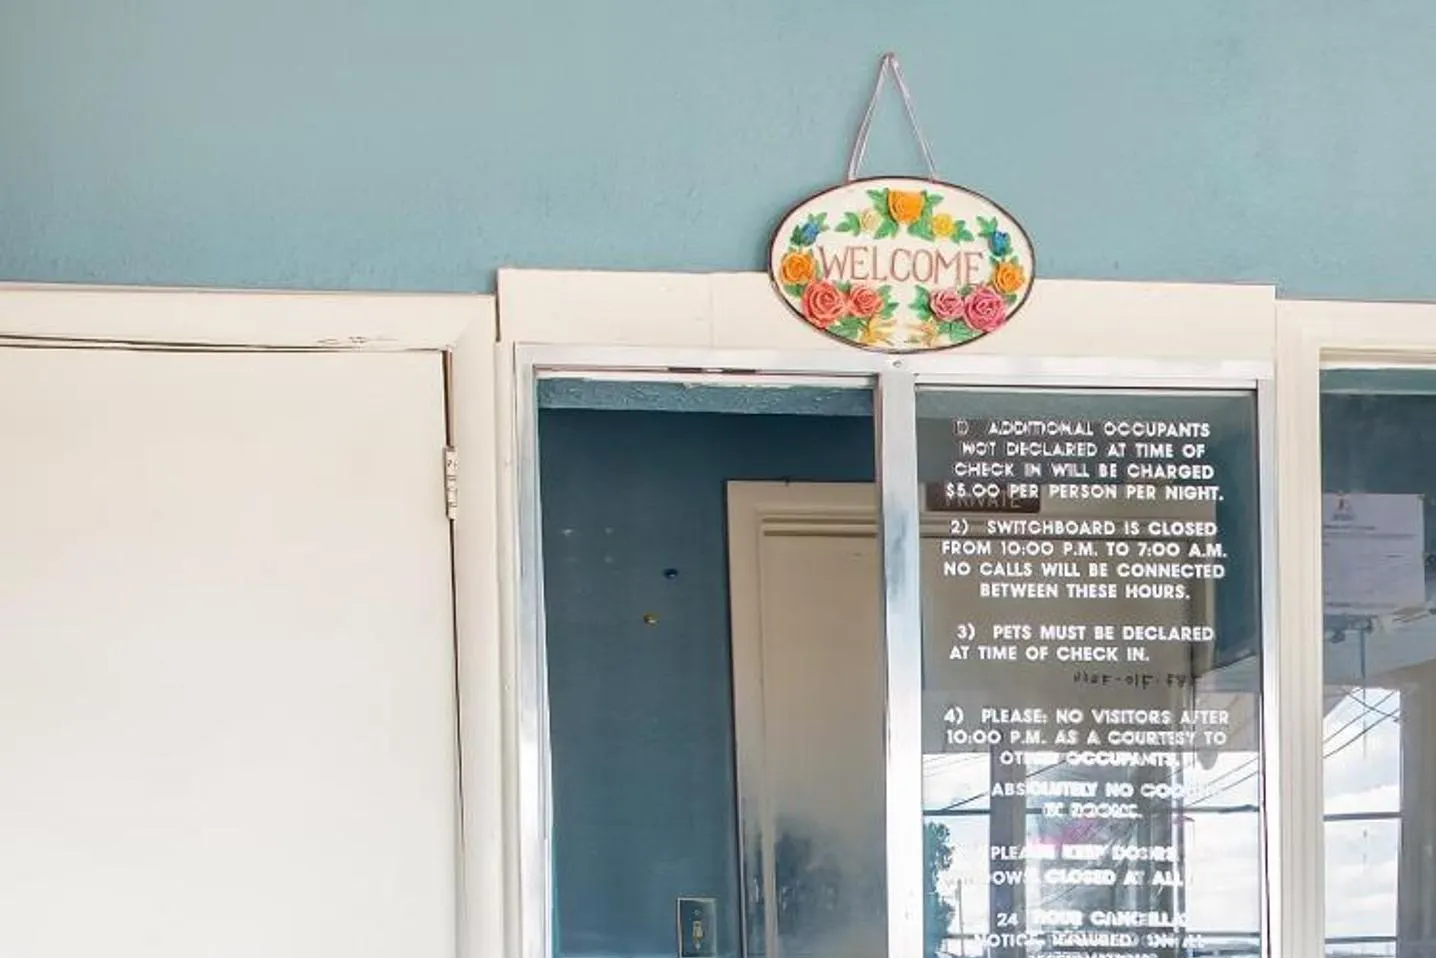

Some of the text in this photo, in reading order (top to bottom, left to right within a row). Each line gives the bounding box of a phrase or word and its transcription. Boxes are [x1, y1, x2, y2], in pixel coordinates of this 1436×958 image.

[819, 246, 984, 286] WELCOME
[988, 421, 1094, 437] ADDITIONAL
[1104, 421, 1211, 437] OCCUPANTS
[962, 443, 1206, 458] NOT DECLARED AT TIME OF
[954, 463, 1214, 479] CHECK IN WILL BE CHARGED
[946, 483, 1224, 500] $5.00 PER PERSON PER NIGHT.
[951, 520, 1217, 536] 2) SWITCHBOARD IS CLOSED
[941, 541, 1228, 557] FROM 10:00 P.M. TO 7:00 A.M.
[944, 562, 1225, 578] NO CALLS WILL BE CONNECTED
[980, 583, 1191, 599] BETWEEN THESE HOURS.
[956, 624, 1215, 641] 3) PETS MUST BE DECLARED
[949, 646, 1150, 662] AT TIME OF CHECK IN.
[944, 708, 964, 725] 4)
[1056, 708, 1084, 725] NO
[1091, 708, 1172, 725] VISITORS
[1180, 708, 1229, 725] AFTER
[946, 730, 1227, 746] 10:00 P.M. AS A COURTESY TO
[991, 782, 1099, 798] ABSOLUTELY
[1106, 782, 1134, 798] NO
[991, 846, 1056, 862] PLEA
[1045, 869, 1116, 886] CLOSED
[997, 911, 1018, 928] 24
